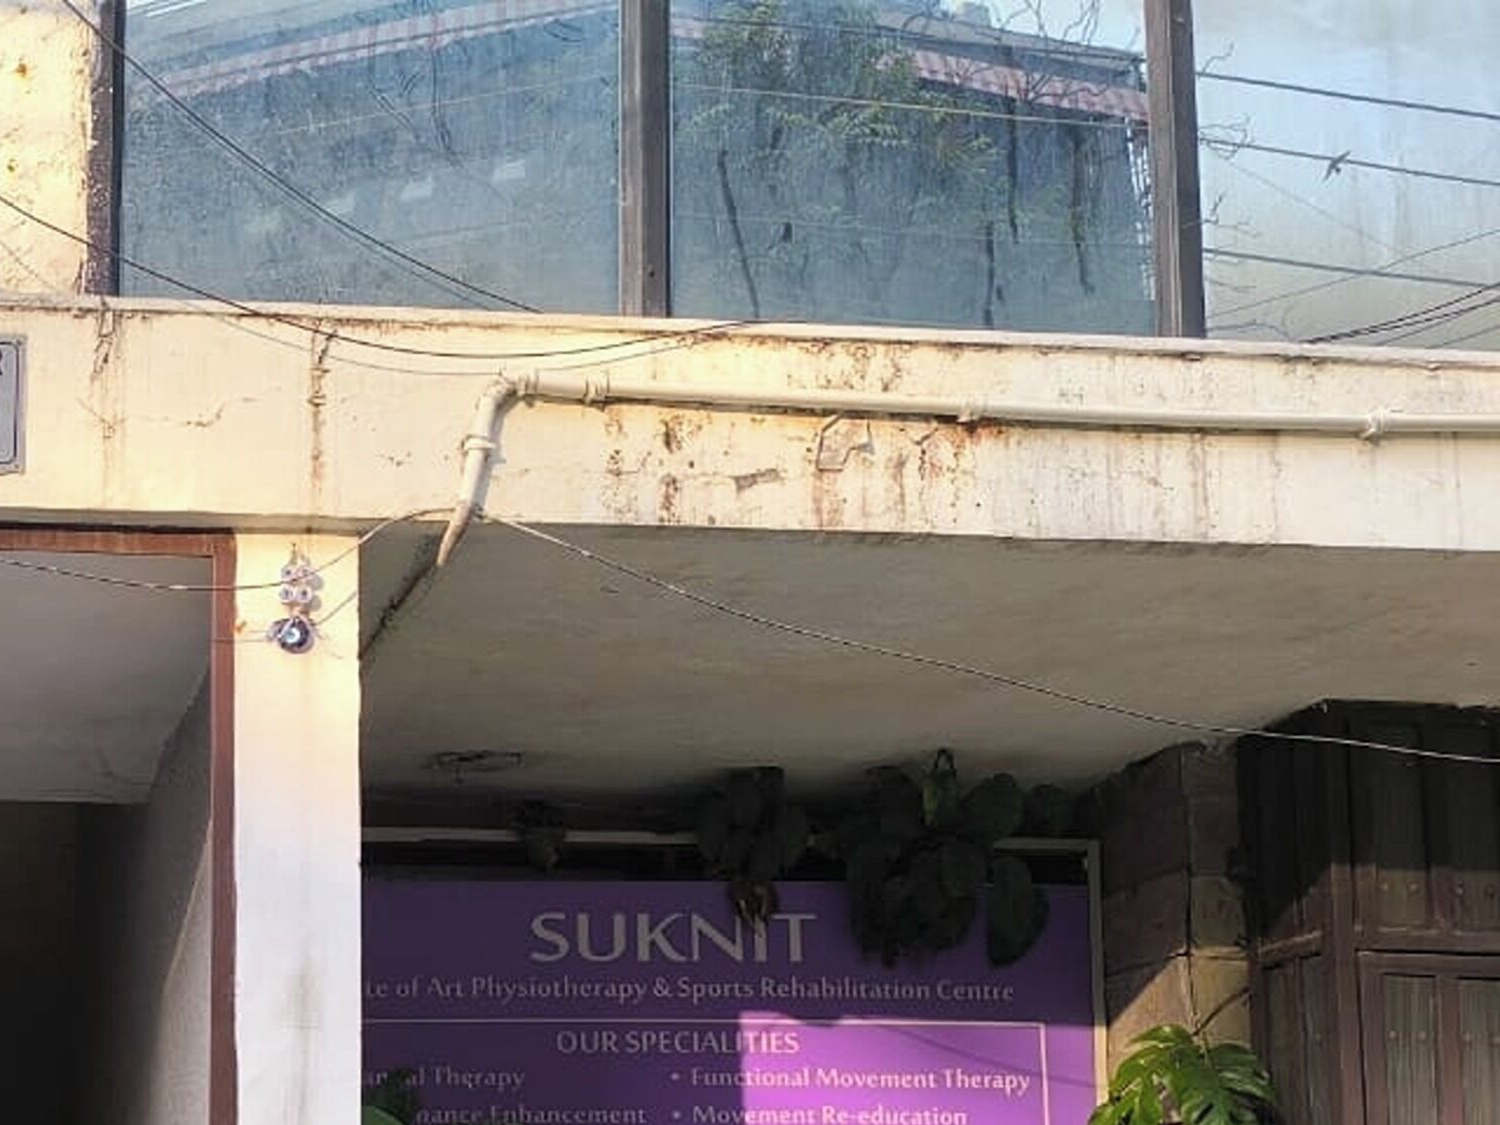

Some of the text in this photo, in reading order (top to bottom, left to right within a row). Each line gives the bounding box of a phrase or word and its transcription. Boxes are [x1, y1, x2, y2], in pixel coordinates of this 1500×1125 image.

[529, 911, 819, 963] SUKNIT
[396, 975, 420, 999] of
[427, 976, 465, 999] Art
[471, 975, 648, 1005] Physiotherapy
[653, 977, 673, 999] &
[677, 977, 751, 1006] Sports
[760, 976, 931, 1001] Rehabilitation
[937, 979, 1015, 1001] Centre
[556, 1030, 801, 1055] OUR SPECIALITIES
[434, 1066, 526, 1092] Therapy
[692, 1068, 809, 1088] Functional
[815, 1068, 936, 1090] Movement
[943, 1069, 1031, 1097] Therapy
[693, 1106, 814, 1125] Movement
